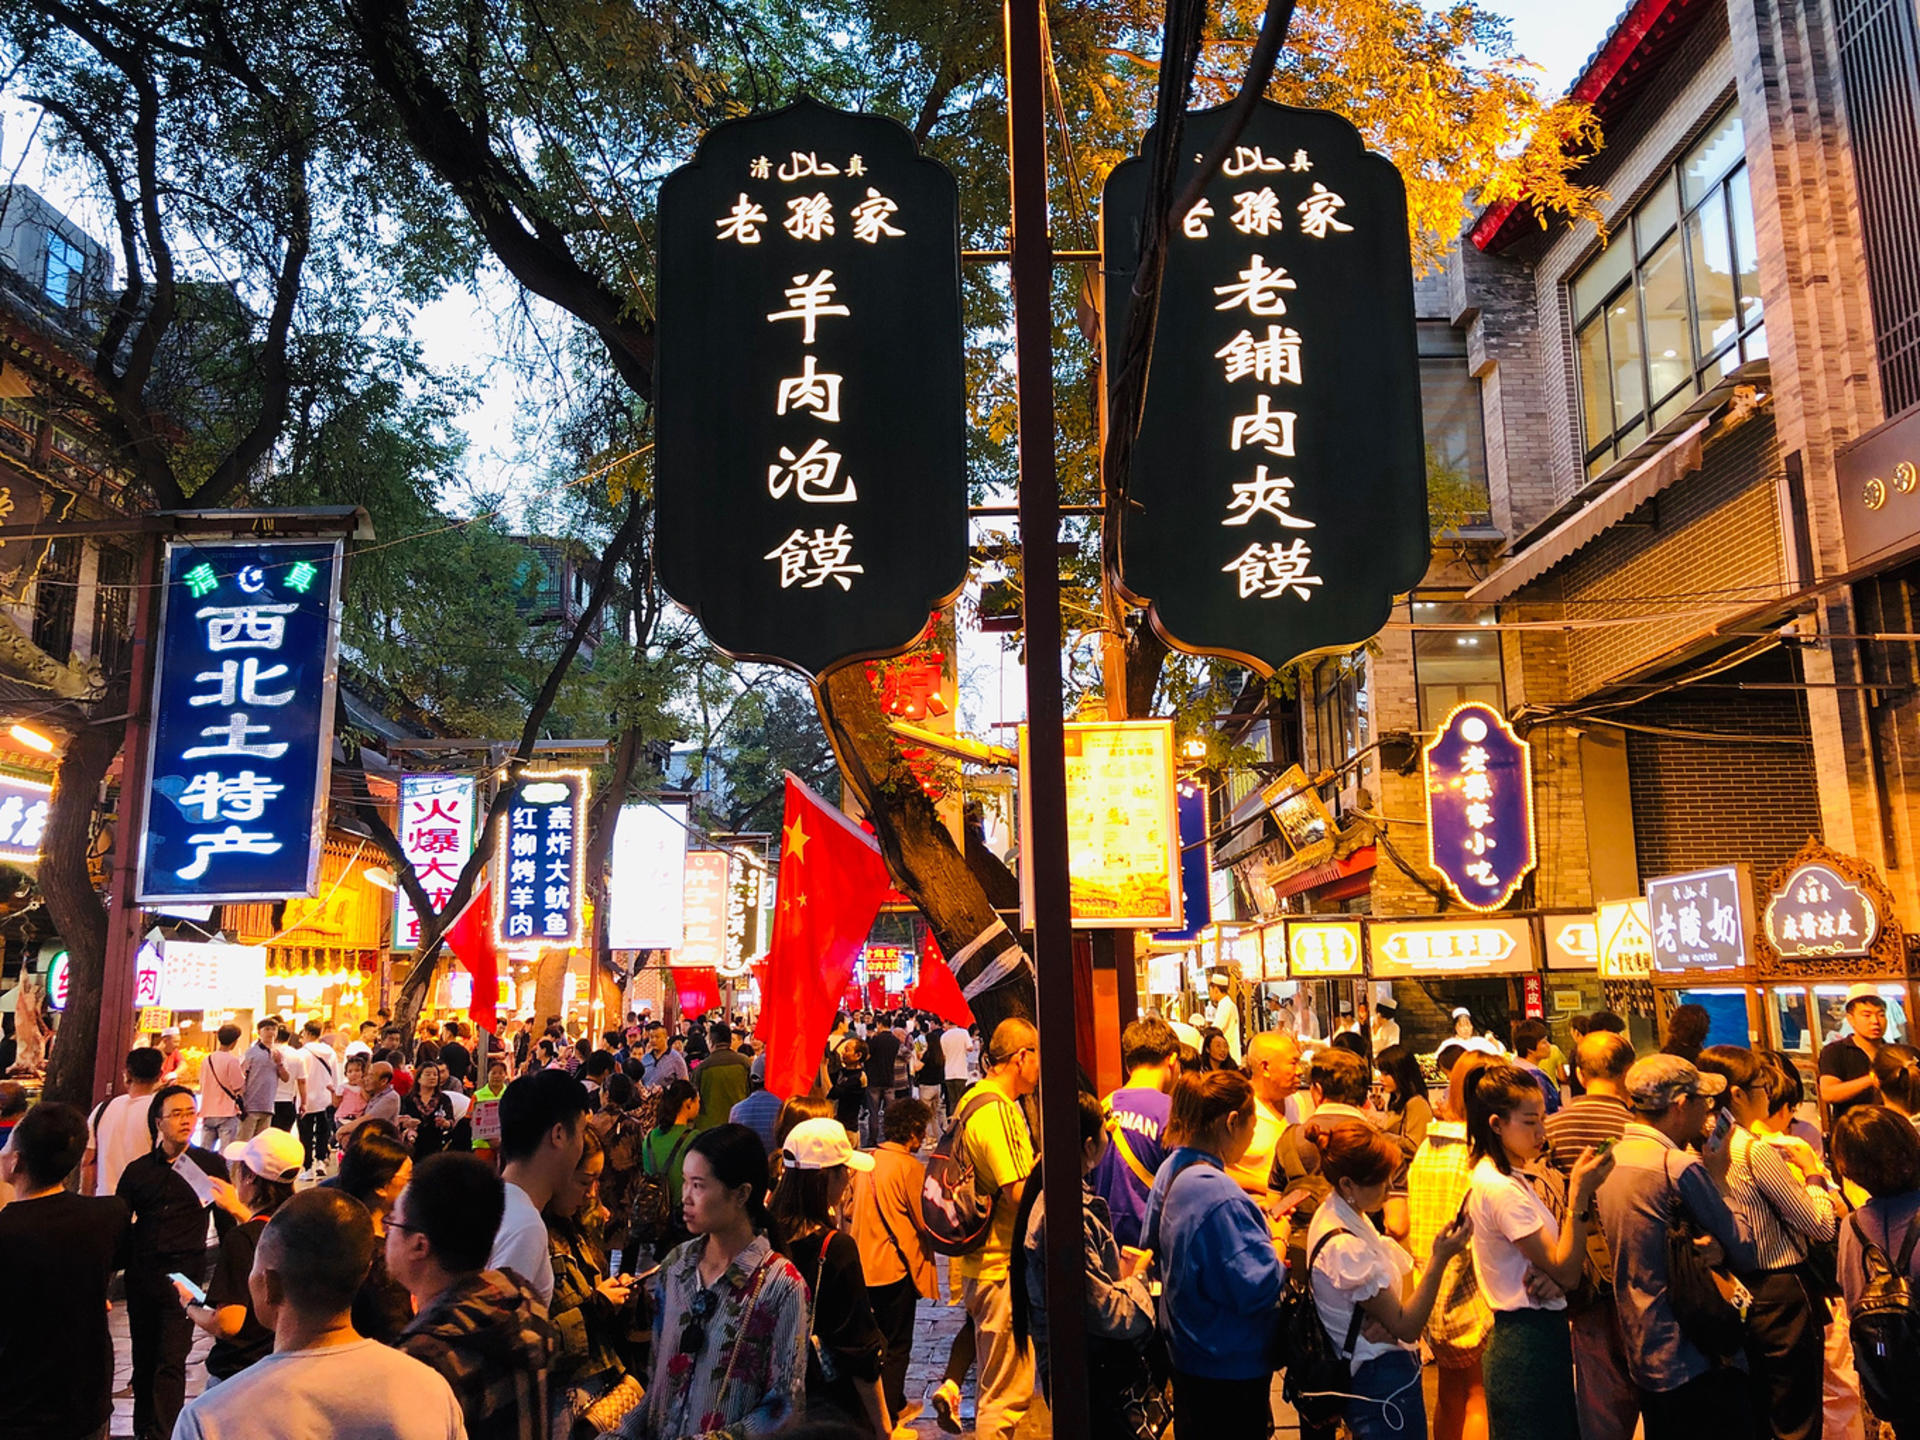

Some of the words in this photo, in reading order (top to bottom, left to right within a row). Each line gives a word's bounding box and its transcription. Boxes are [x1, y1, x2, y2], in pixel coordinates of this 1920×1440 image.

[717, 188, 905, 243] 老孫家
[751, 156, 772, 178] 清
[845, 154, 867, 176] 真
[1290, 149, 1313, 171] 真
[765, 270, 863, 590] 羊肉泡饃
[1214, 255, 1322, 600] 老鋪肉夾饃
[177, 602, 299, 881] 西北土特产
[509, 806, 538, 936] 红柳烤羊肉
[543, 805, 572, 936] 轰炸大鱿鱼
[1655, 897, 1737, 953] 老酸奶
